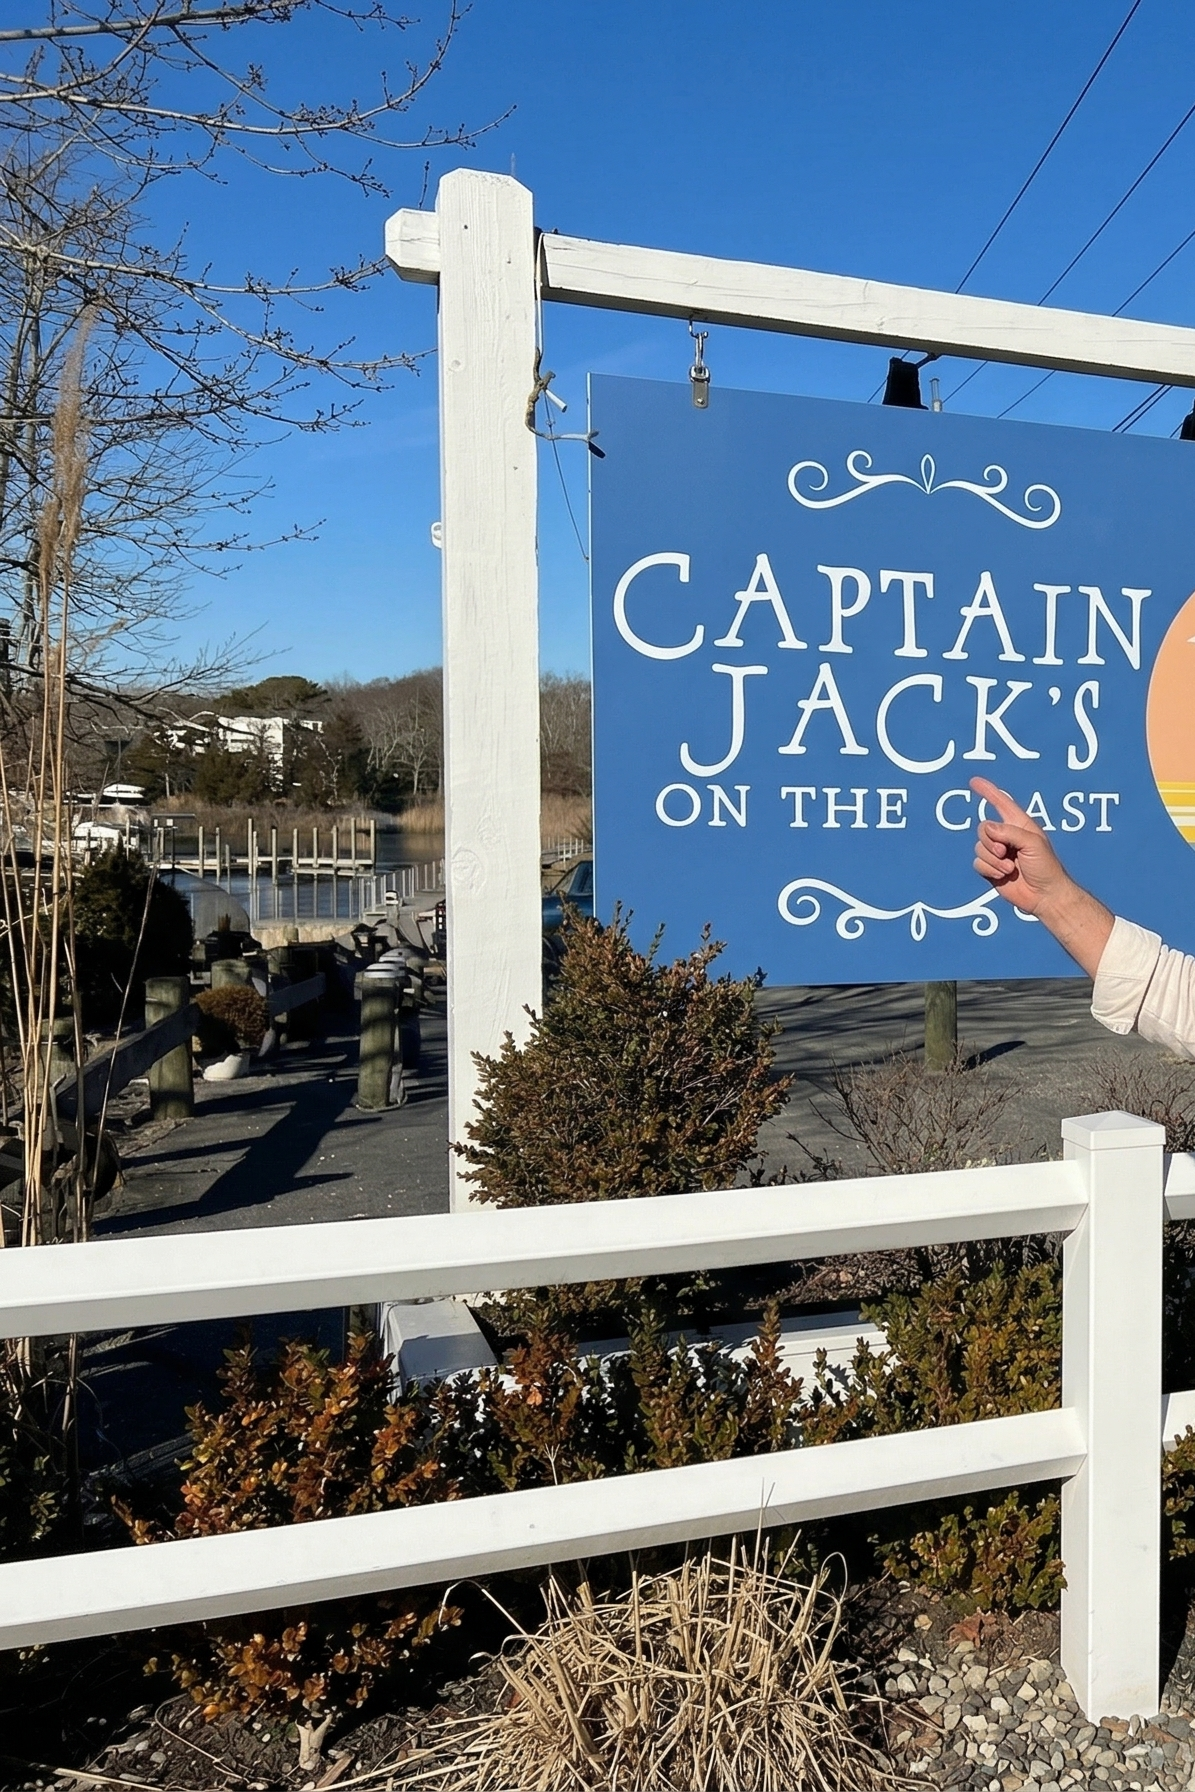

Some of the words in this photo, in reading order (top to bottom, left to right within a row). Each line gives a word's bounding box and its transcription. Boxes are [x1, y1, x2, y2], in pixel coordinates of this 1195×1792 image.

[613, 552, 1152, 671] CAPTAIN
[680, 662, 1101, 778] JACK'S
[655, 783, 751, 828] ON
[780, 786, 909, 830] THE
